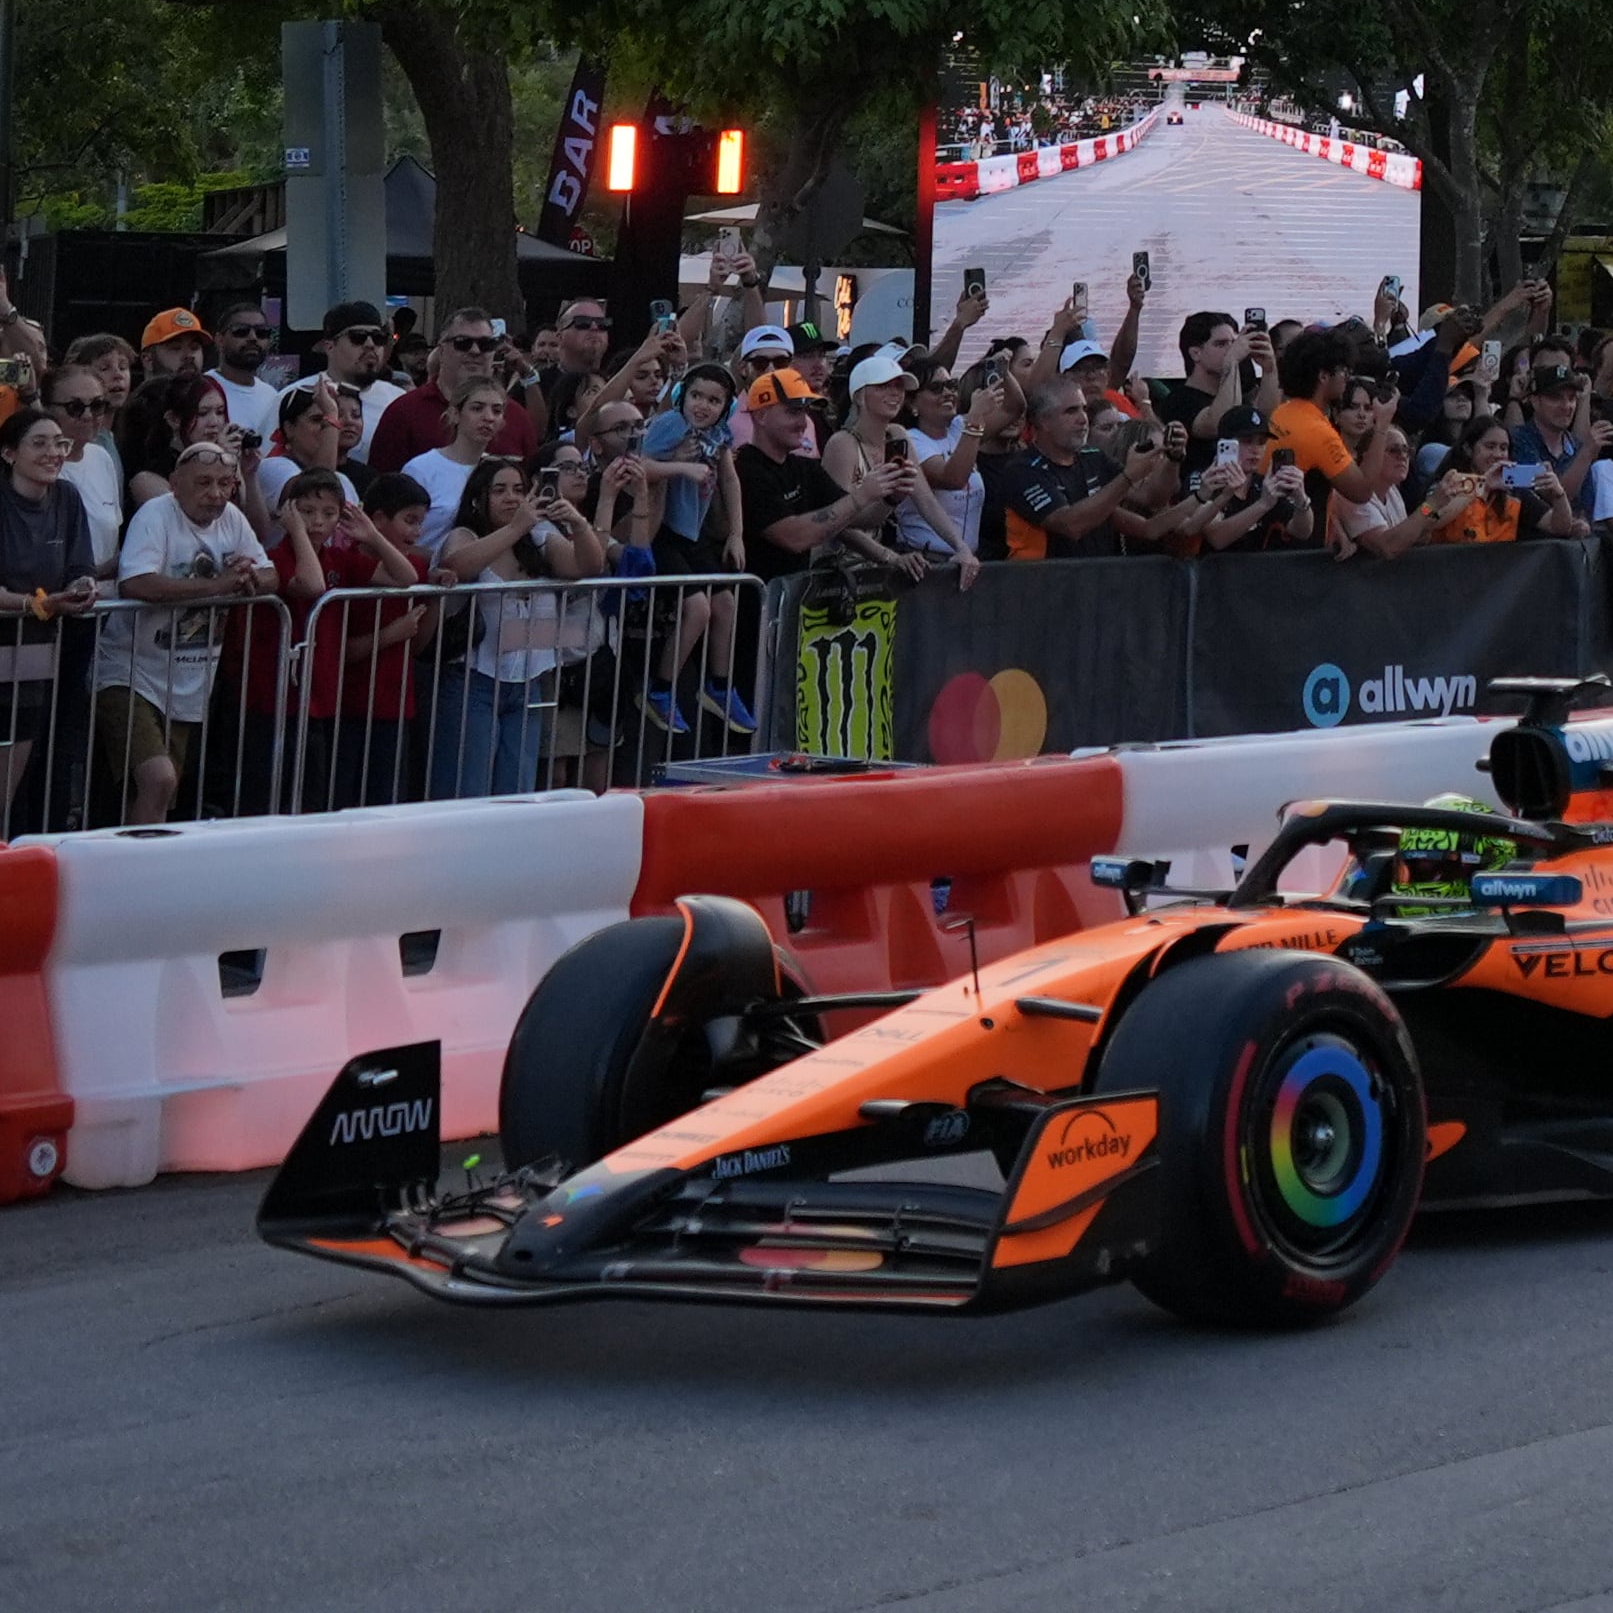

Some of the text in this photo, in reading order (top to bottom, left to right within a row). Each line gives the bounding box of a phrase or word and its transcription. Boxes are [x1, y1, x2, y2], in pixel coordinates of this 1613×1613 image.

[549, 89, 598, 217] BAR
[1358, 664, 1477, 718] allwyn
[1481, 879, 1538, 900] allwyn
[711, 1144, 791, 1179] JACK DANIEL'S
[1047, 1133, 1131, 1169] workday
